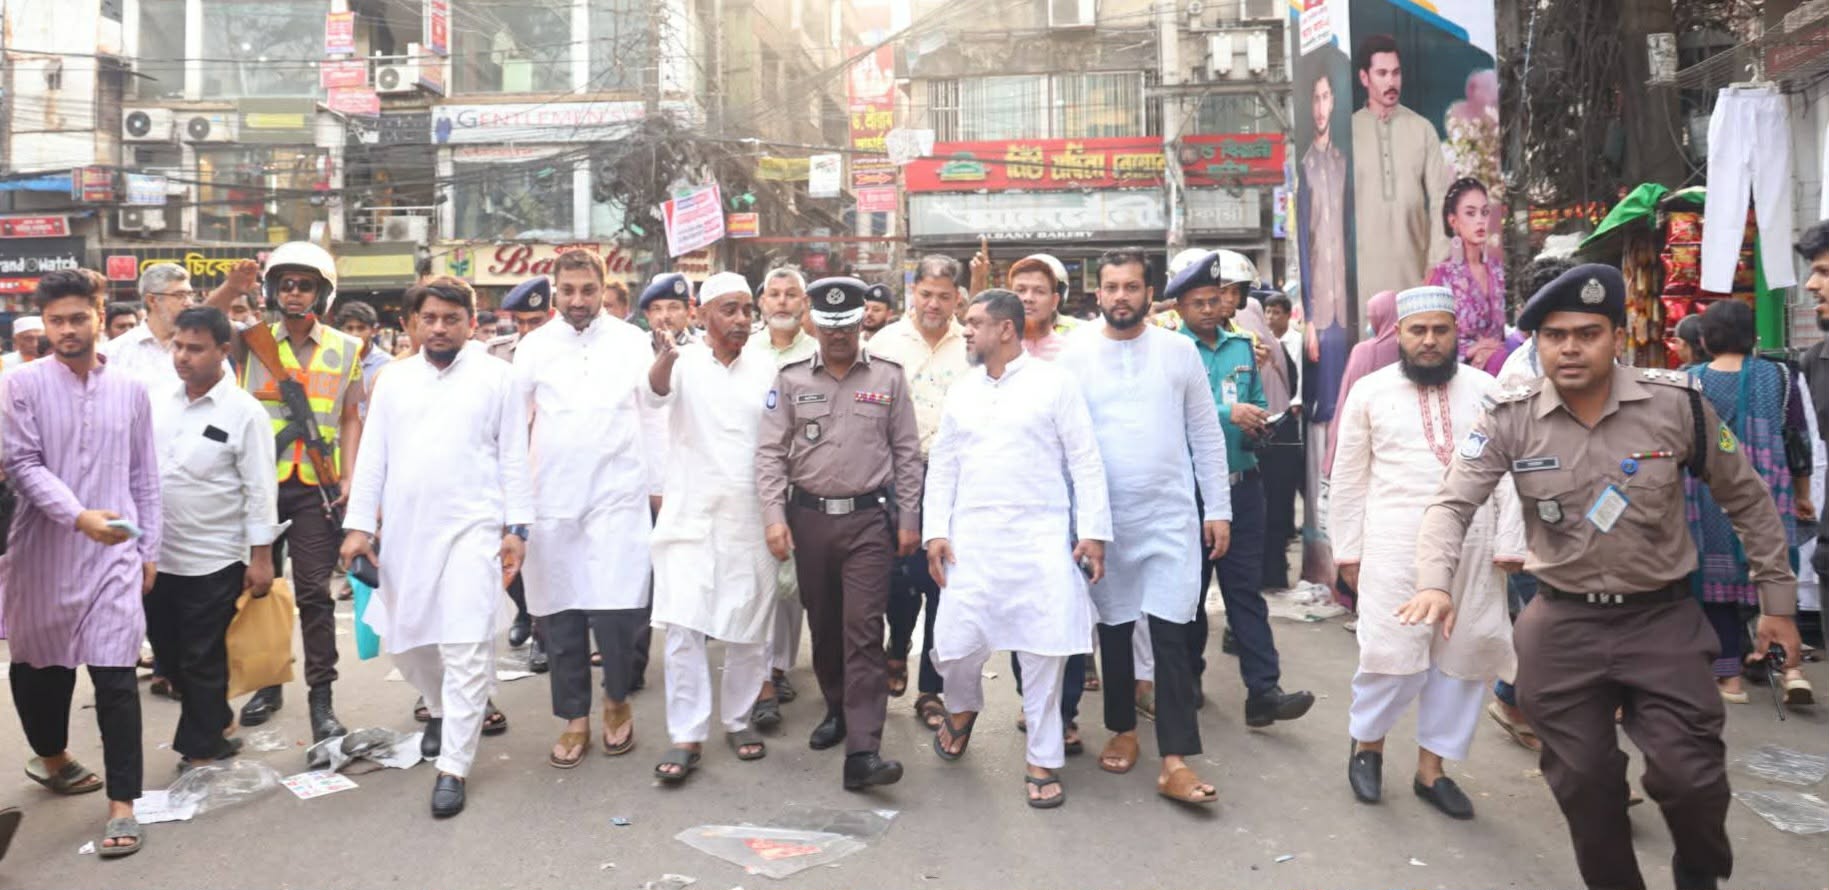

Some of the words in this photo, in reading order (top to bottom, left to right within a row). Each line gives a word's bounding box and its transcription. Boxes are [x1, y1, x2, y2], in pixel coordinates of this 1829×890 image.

[976, 231, 1032, 240] ALBANY
[1037, 231, 1094, 239] BAKERY
[39, 257, 79, 273] Watch
